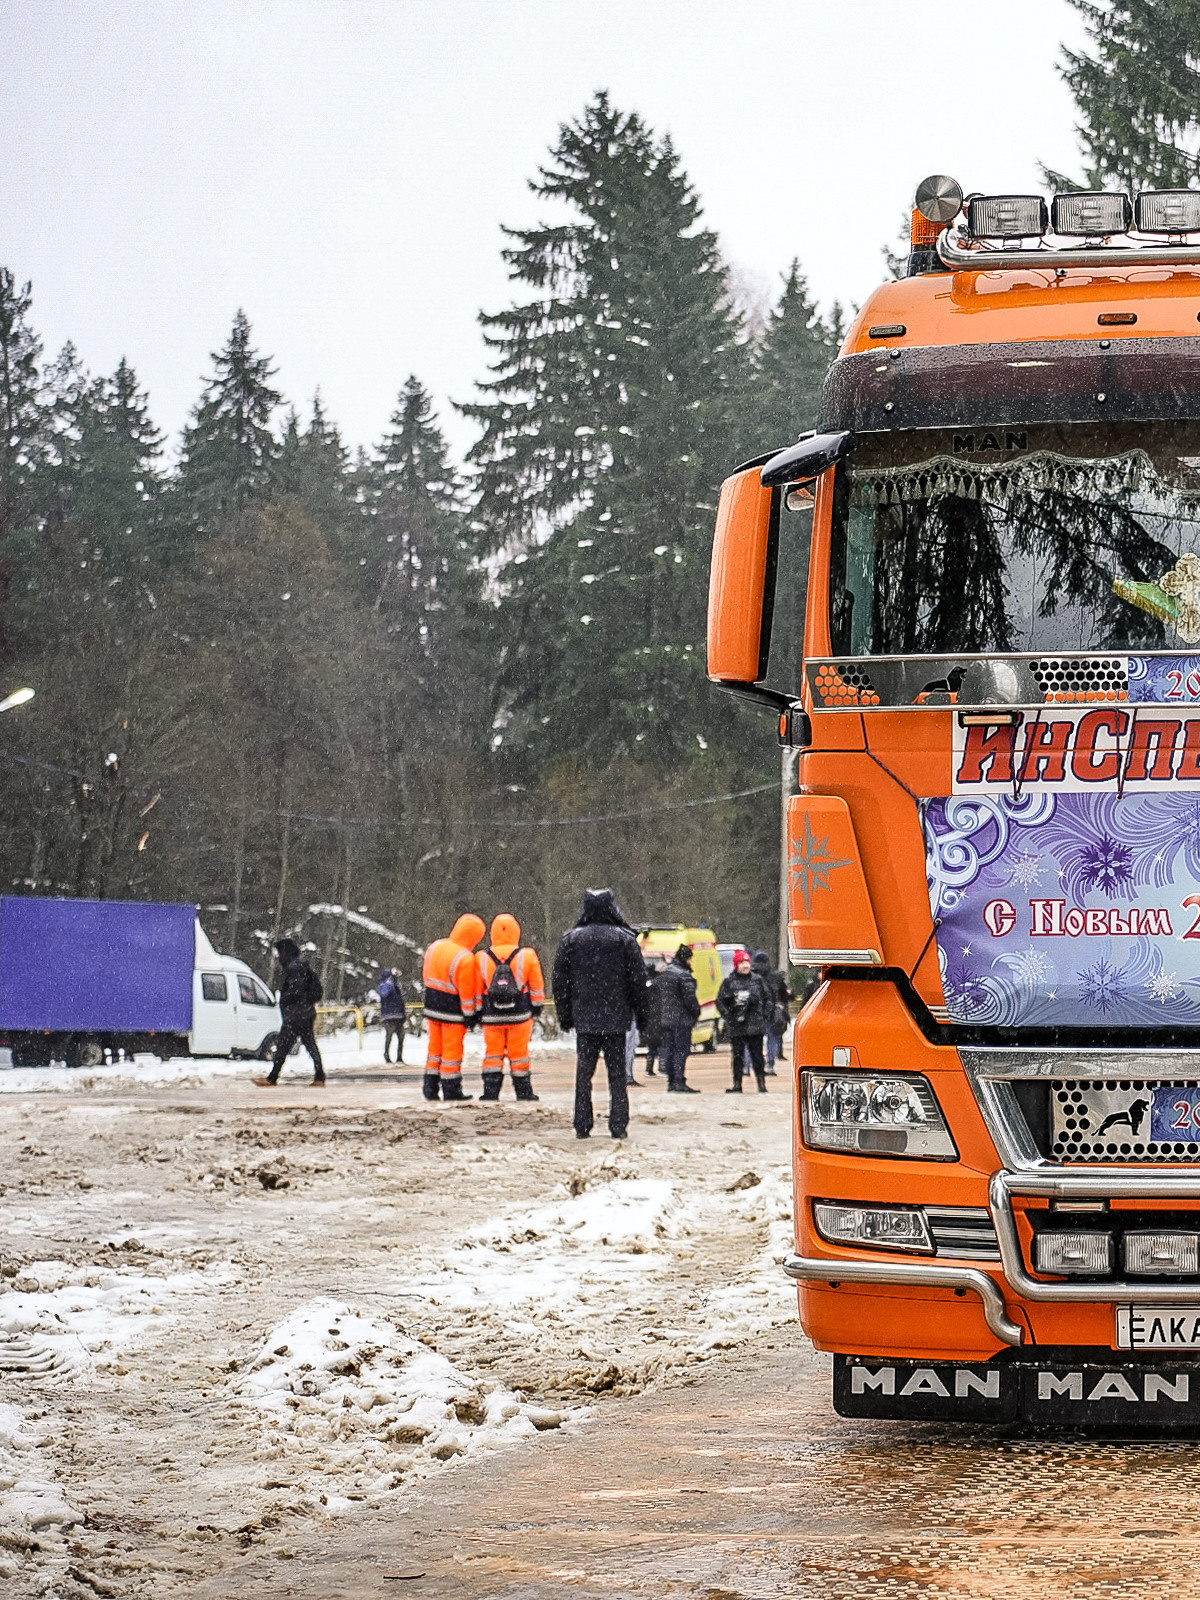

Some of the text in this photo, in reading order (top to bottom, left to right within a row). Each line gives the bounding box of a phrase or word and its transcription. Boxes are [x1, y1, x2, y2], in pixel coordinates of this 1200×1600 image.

[953, 431, 1028, 453] MAN
[983, 899, 1016, 937] С
[851, 1367, 999, 1398] MAN
[1038, 1372, 1189, 1402] MAN
